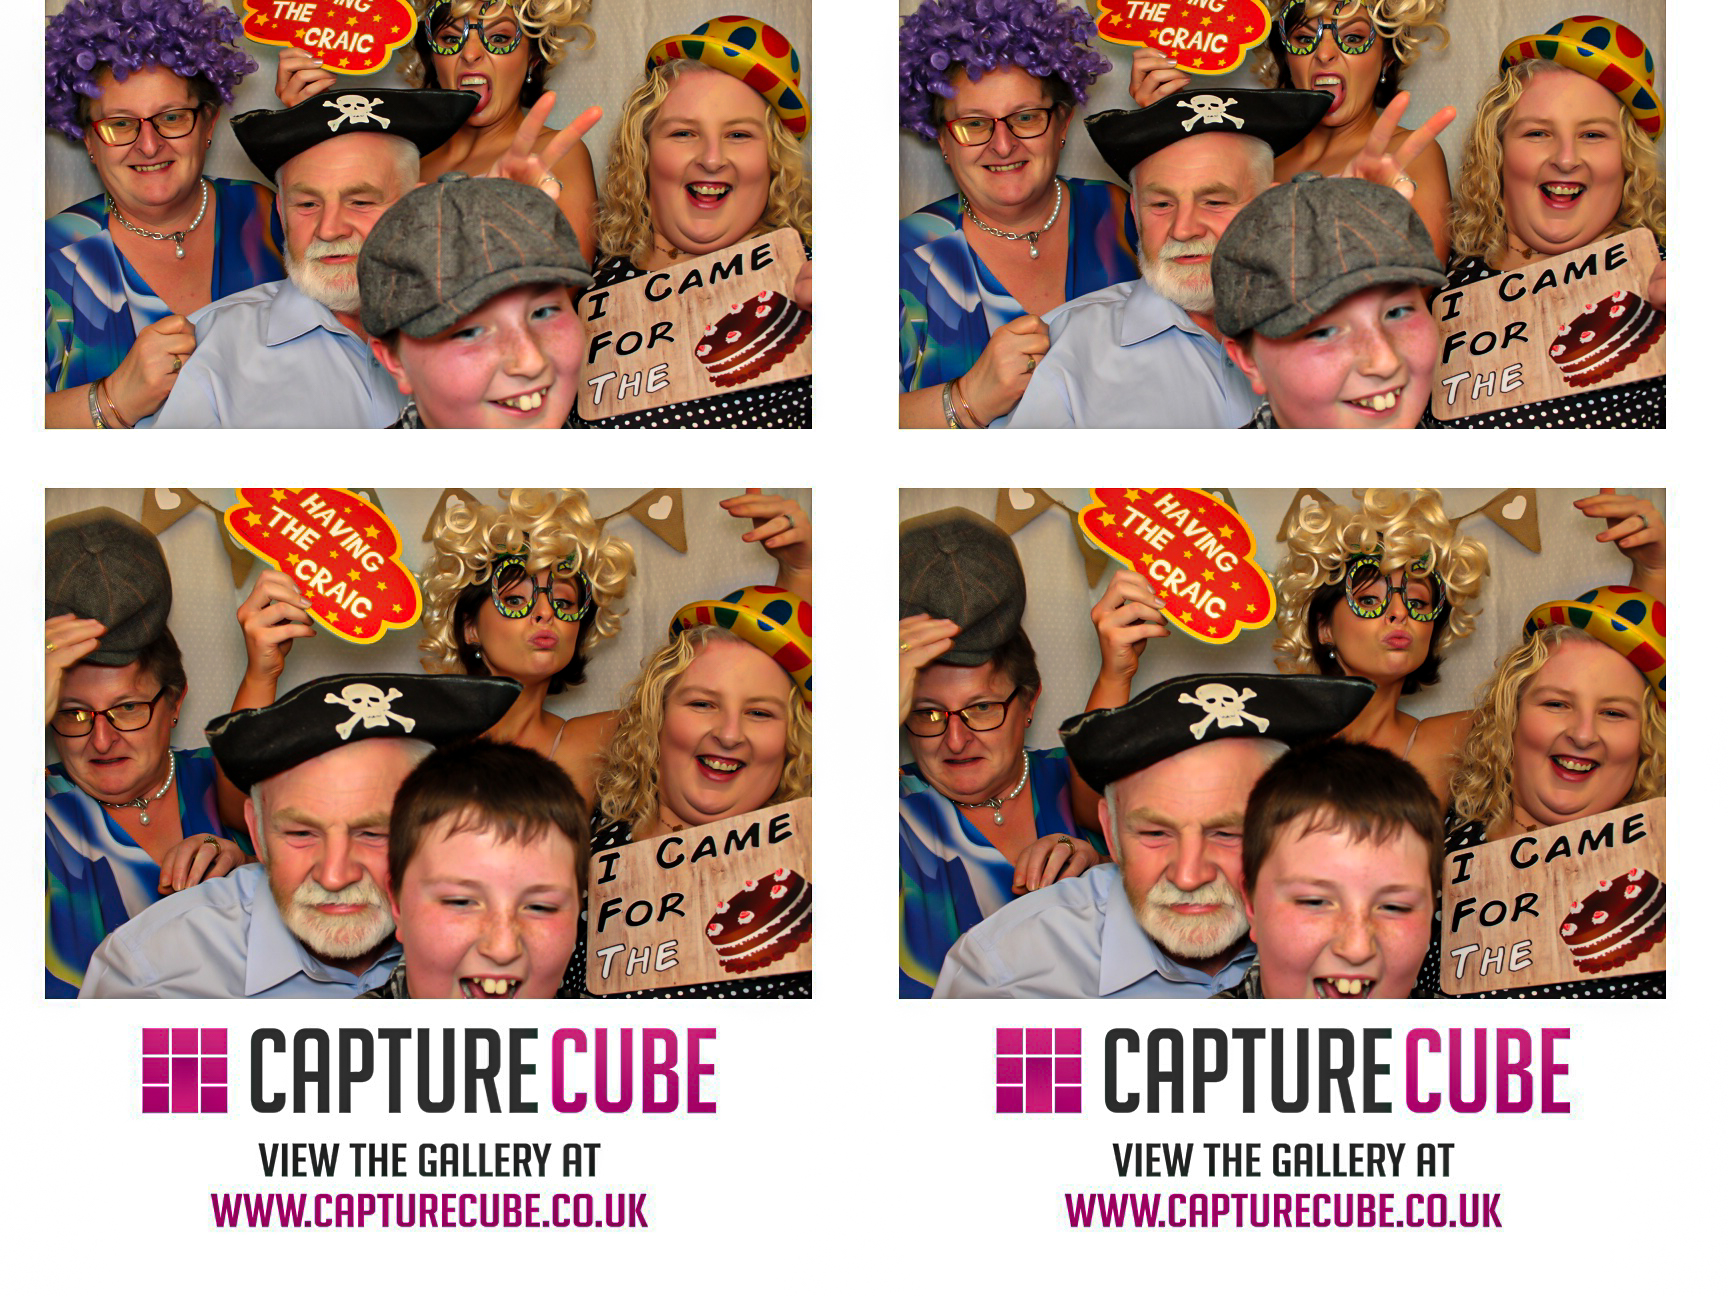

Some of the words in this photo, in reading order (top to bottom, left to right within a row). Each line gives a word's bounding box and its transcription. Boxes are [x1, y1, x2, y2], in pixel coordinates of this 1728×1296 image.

[272, 0, 317, 23] THE
[1126, 0, 1171, 23] THE
[303, 27, 375, 53] CRAIC
[1157, 27, 1229, 53] CRAIC
[588, 291, 610, 321] I
[645, 243, 774, 302] CAME
[1442, 291, 1464, 321] I
[1499, 243, 1628, 302] CAME
[588, 321, 674, 364] FOR
[1442, 321, 1528, 364] FOR
[588, 362, 670, 405] THE
[1442, 362, 1524, 405] THE
[268, 505, 322, 552] THE
[300, 492, 384, 573] HAVING
[1122, 505, 1176, 552] THE
[1154, 492, 1238, 573] HAVING
[294, 559, 372, 619] CRAIC
[1148, 559, 1226, 619] CRAIC
[597, 852, 620, 885] I
[656, 813, 793, 869] CAME
[1451, 852, 1474, 885] I
[1510, 813, 1647, 869] CAME
[597, 892, 686, 933] FOR
[1451, 892, 1540, 933] FOR
[596, 939, 679, 979] THE
[1450, 939, 1533, 979] THE
